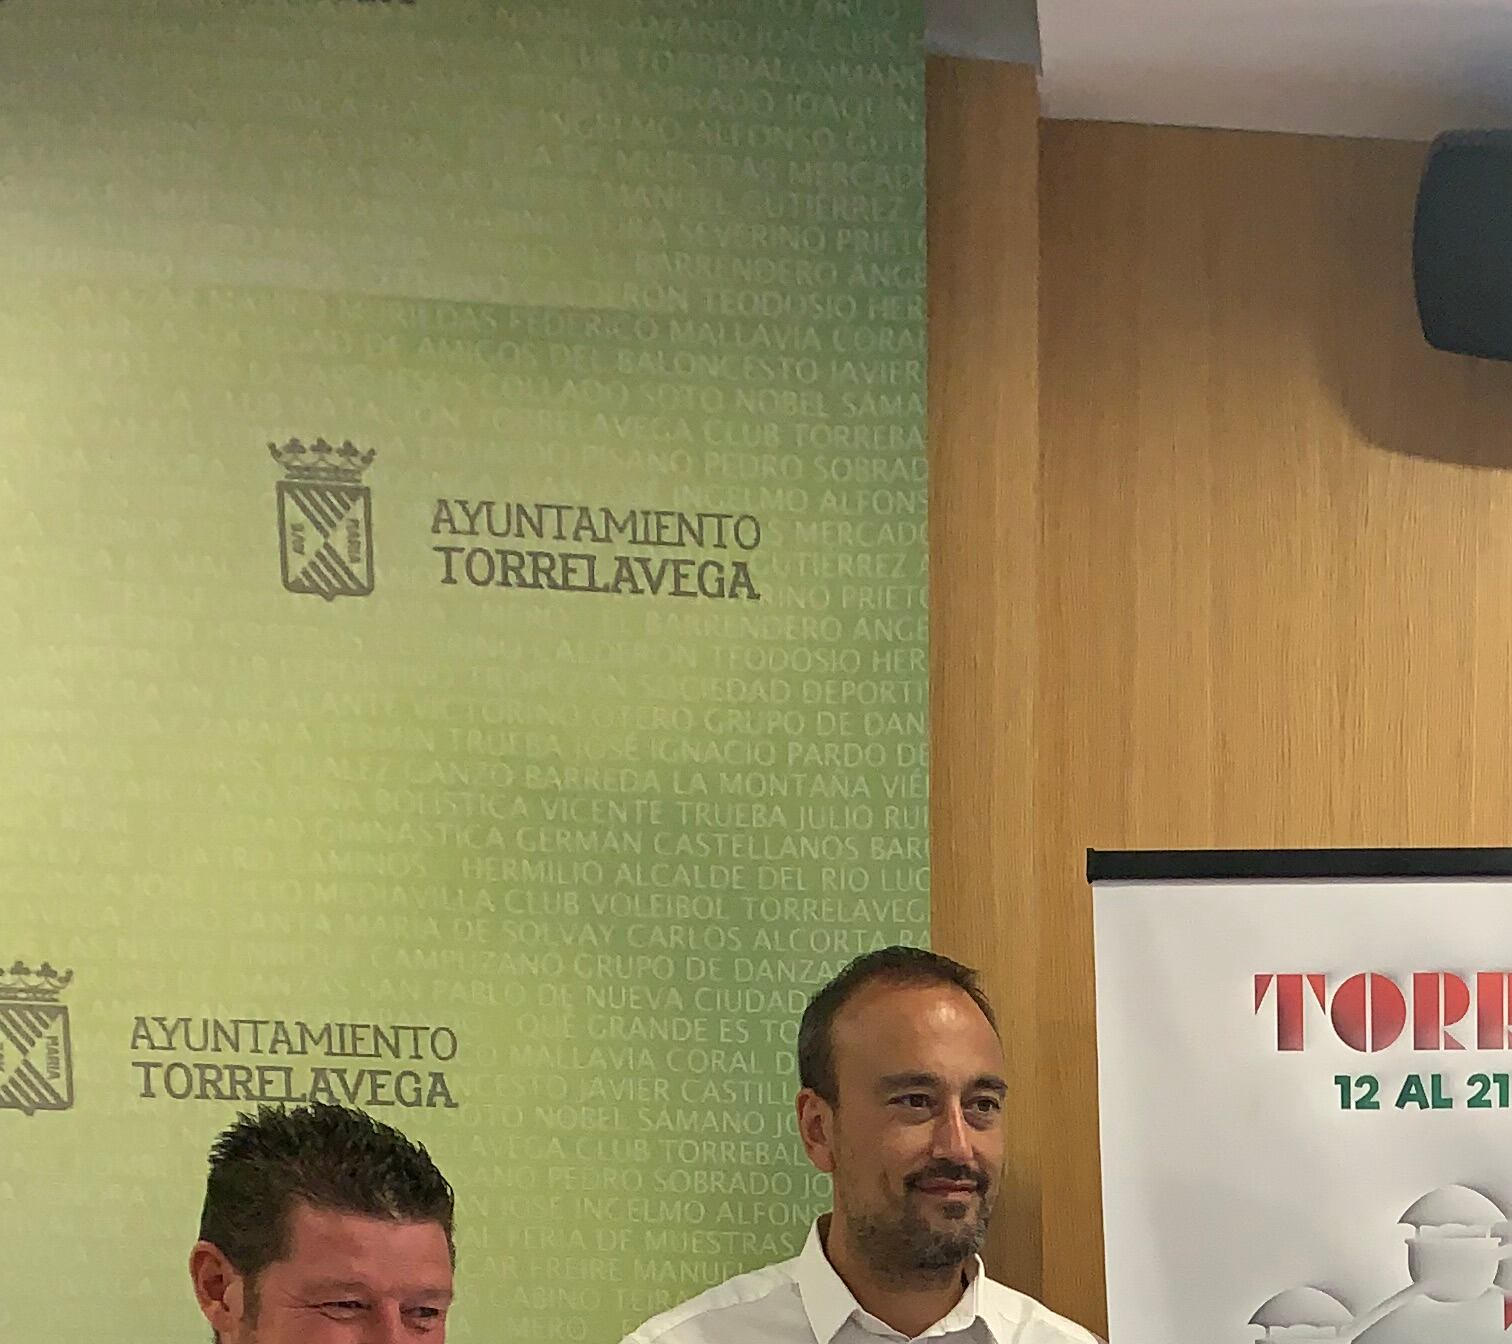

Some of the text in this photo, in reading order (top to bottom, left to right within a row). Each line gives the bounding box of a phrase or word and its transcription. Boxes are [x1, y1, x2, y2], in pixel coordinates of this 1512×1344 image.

[431, 499, 761, 550] AYUNTAMIENTO
[432, 546, 761, 600] TORRELAVEGA
[802, 678, 928, 706] DEPORTI
[817, 710, 852, 737] DE
[787, 740, 887, 769] PARDO
[672, 769, 709, 796] LA
[676, 800, 788, 829] TRUEBA
[796, 803, 874, 833] JULIO
[653, 829, 859, 861] CASTELLANOS
[461, 856, 605, 887] HERMILIO
[614, 861, 745, 890] ALCALDE
[758, 865, 807, 892] DEL
[504, 889, 579, 917] CLUB
[590, 891, 730, 921] VOLEIBOL
[626, 923, 742, 952] CARLOS
[574, 953, 675, 981] GRUPO
[686, 956, 724, 983] DE
[735, 957, 841, 985] DANZA
[586, 984, 684, 1012] NUEVA
[694, 987, 809, 1015] CIUDAD
[130, 1016, 459, 1061] AYUNTAMIENTO
[587, 1014, 707, 1044] GRANDE
[719, 1017, 750, 1044] ES
[665, 1047, 764, 1076] CORAL
[131, 1061, 459, 1108] TORRELAVEGA
[680, 1078, 801, 1108] CASTILL
[1332, 1073, 1381, 1111] 12
[1394, 1072, 1454, 1110] AL
[1466, 1071, 1510, 1109] 21
[548, 1165, 644, 1192] PEDRO
[653, 1168, 794, 1197] SOBRADO
[645, 1229, 795, 1256] MUESTRAS
